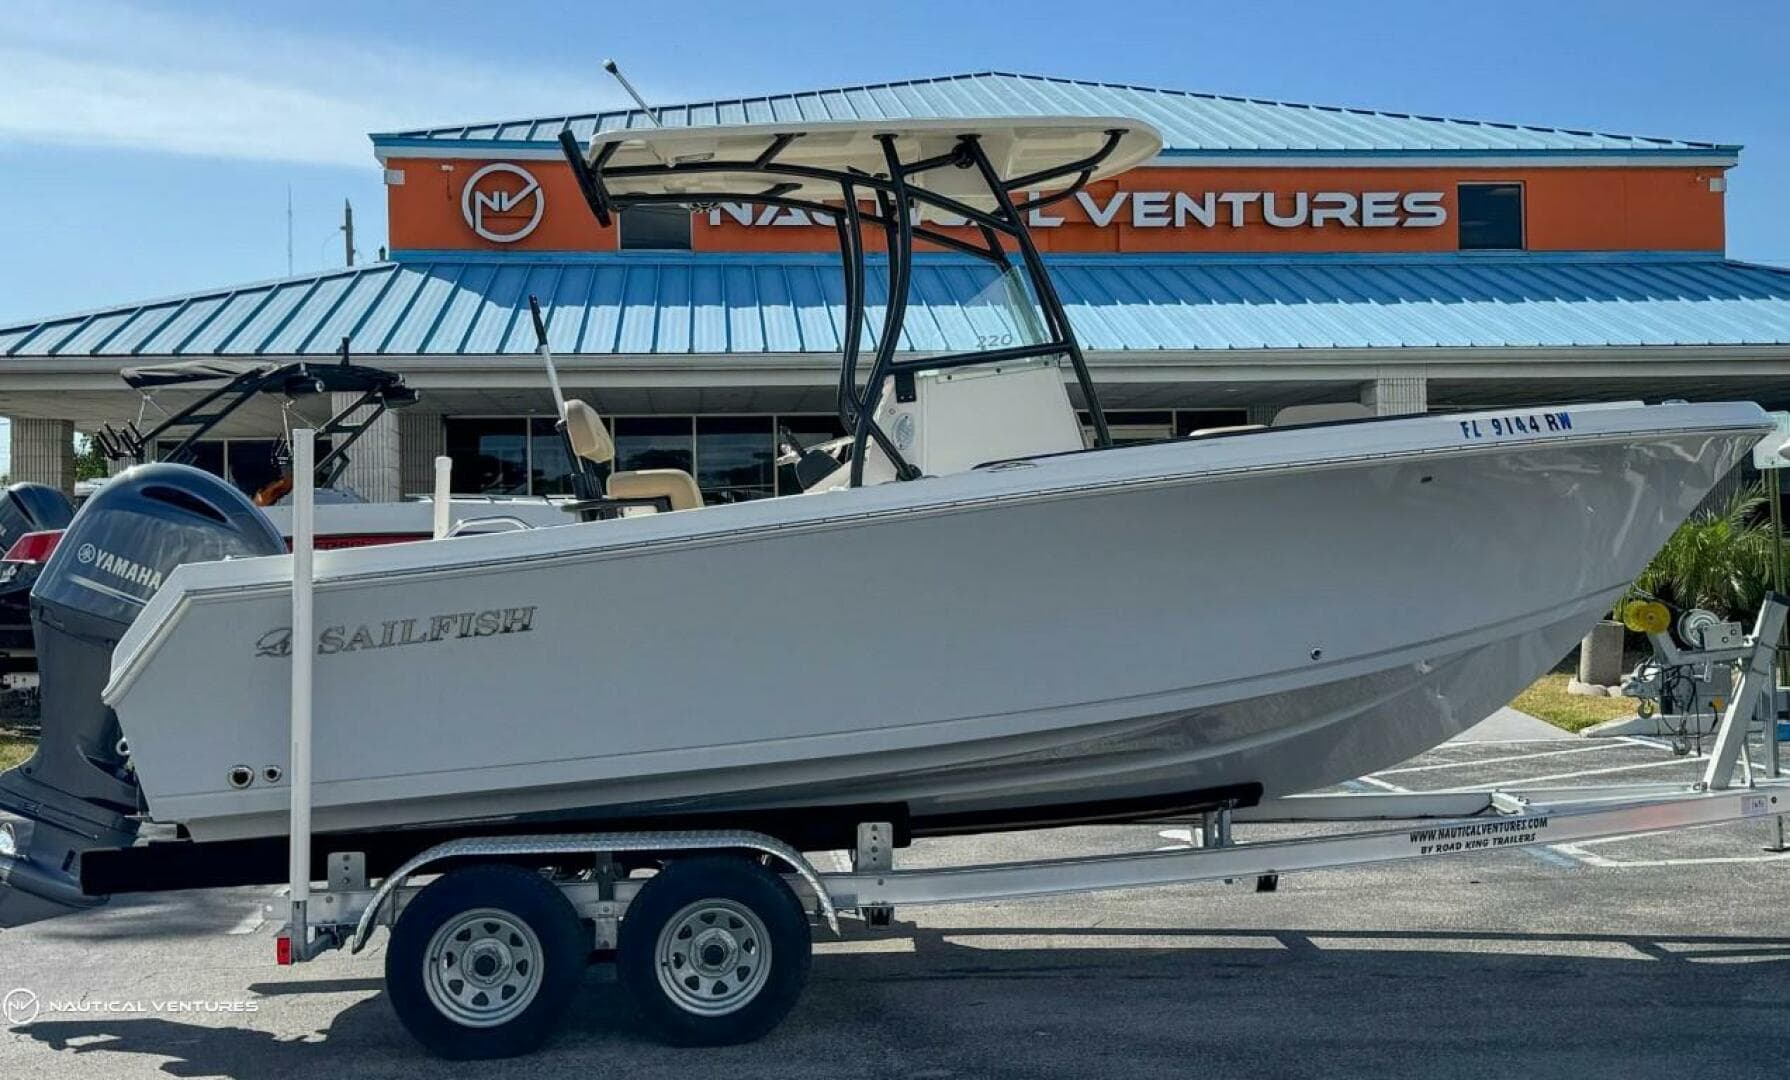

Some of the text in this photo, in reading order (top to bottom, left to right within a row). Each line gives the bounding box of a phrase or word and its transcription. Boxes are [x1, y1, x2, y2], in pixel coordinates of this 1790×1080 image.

[1076, 192, 1447, 227] VENTURES
[976, 334, 1013, 347] 220
[1460, 412, 1573, 438] FL 9144 RW
[95, 549, 162, 590] YAMAHA
[315, 606, 537, 655] SAILFISH
[1409, 817, 1548, 843] WWW.NAUTICALVENTURES.COM
[1421, 832, 1536, 855] BY ROAD KING TRAILERS
